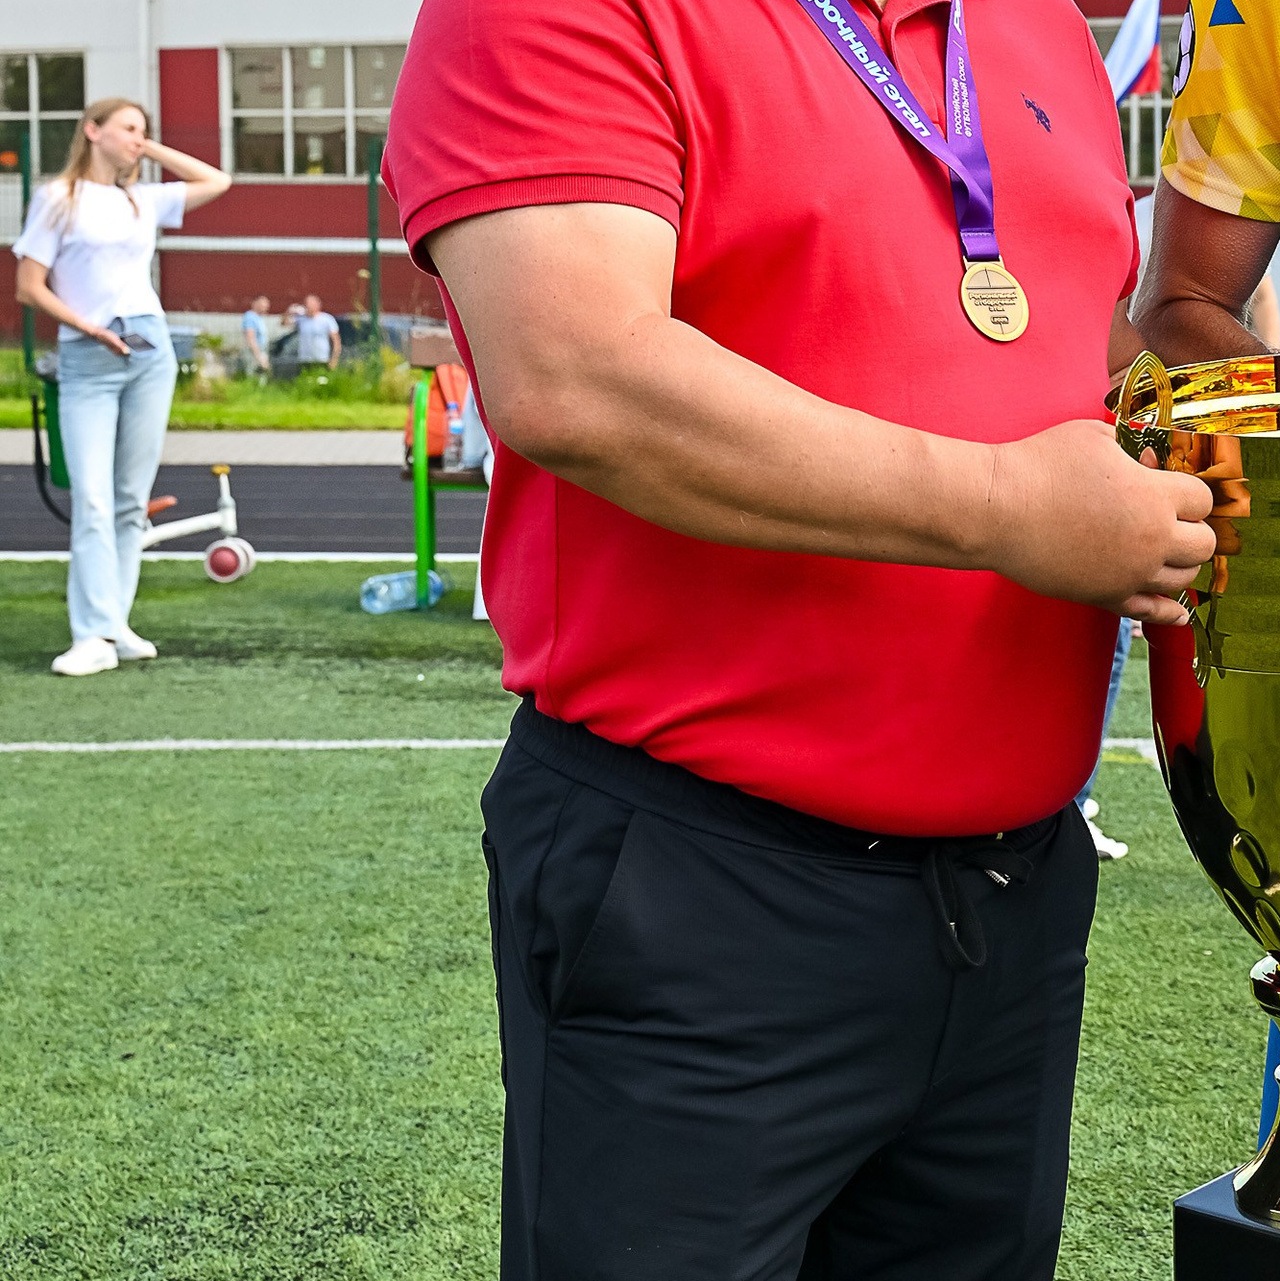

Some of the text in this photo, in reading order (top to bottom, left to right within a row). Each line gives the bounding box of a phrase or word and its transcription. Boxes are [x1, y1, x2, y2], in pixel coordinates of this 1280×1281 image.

[885, 83, 931, 139] этап
[951, 77, 963, 135] РОССИЙСКИЙ
[961, 81, 972, 138] ФУТБОЛЬНЫЙ
